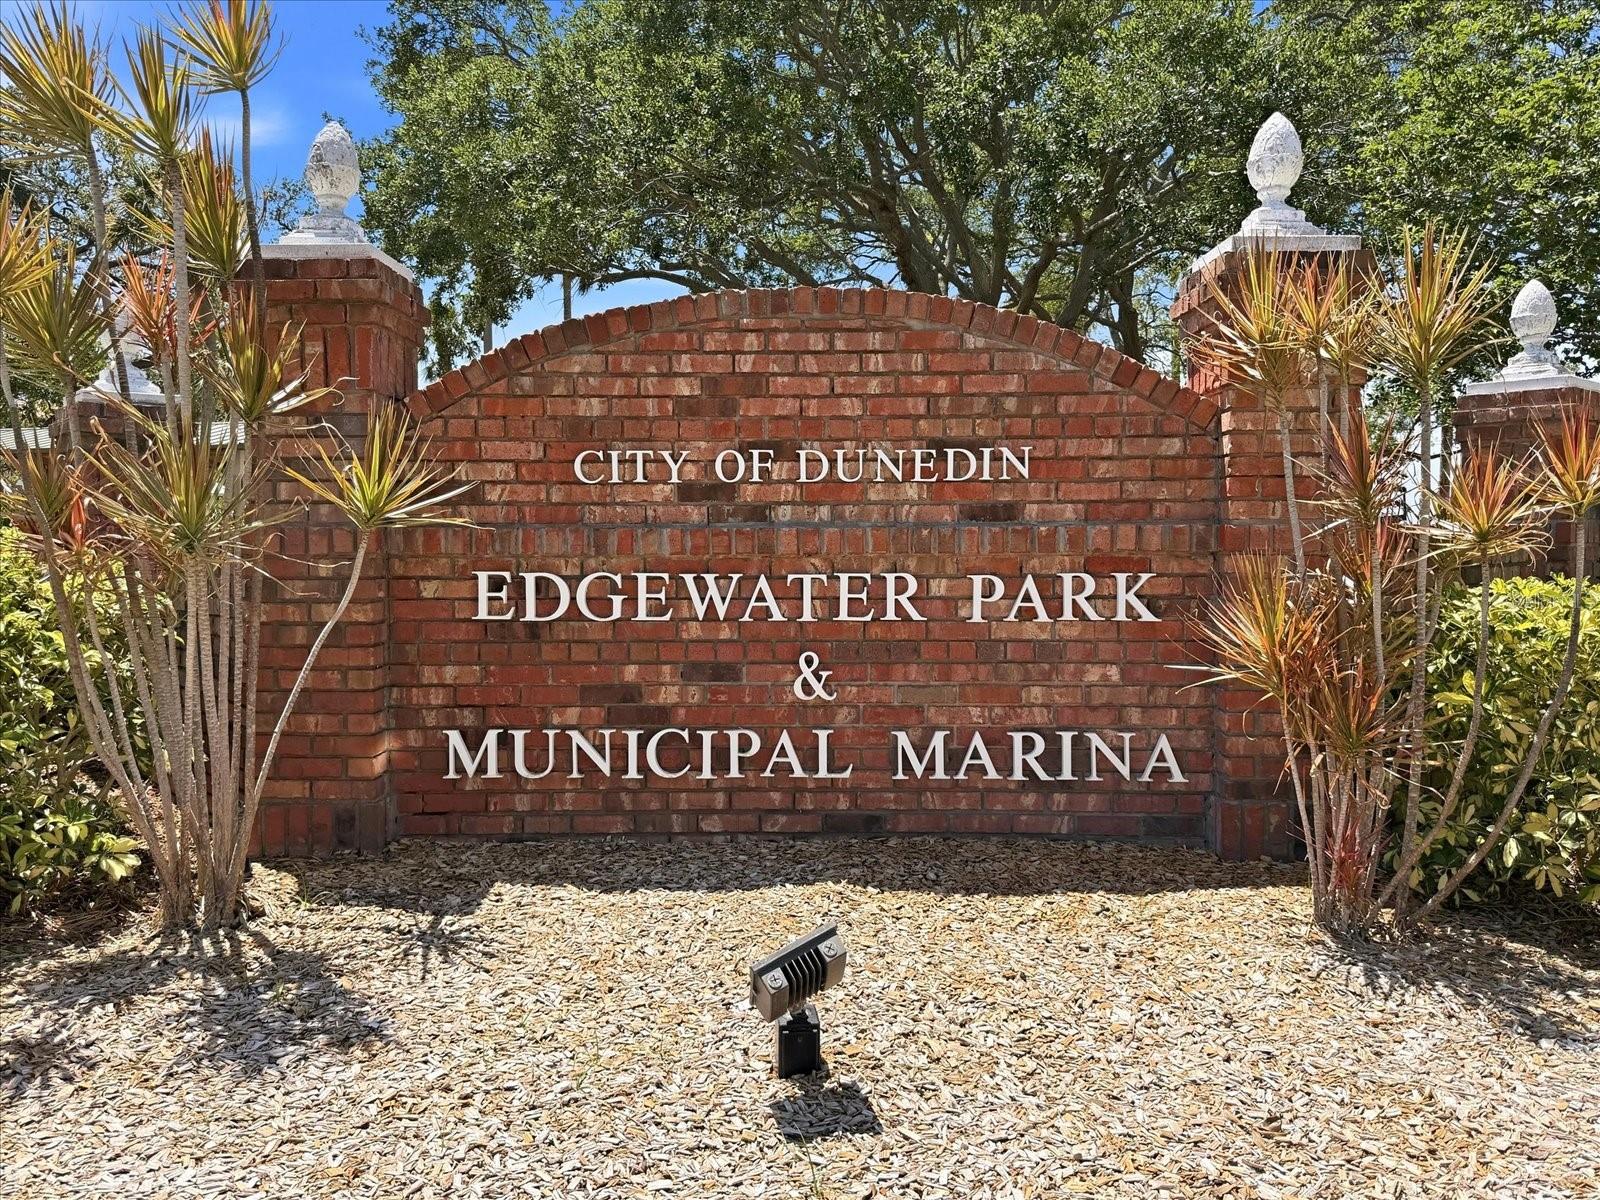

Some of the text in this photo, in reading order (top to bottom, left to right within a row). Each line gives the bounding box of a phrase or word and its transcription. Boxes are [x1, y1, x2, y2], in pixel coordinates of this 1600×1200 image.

[574, 446, 1033, 484] CITY OF DUNEDIN
[471, 571, 1162, 623] EDGEWATER PARK
[793, 651, 837, 702] &
[442, 729, 1189, 784] MUNICIPAL MARINA
